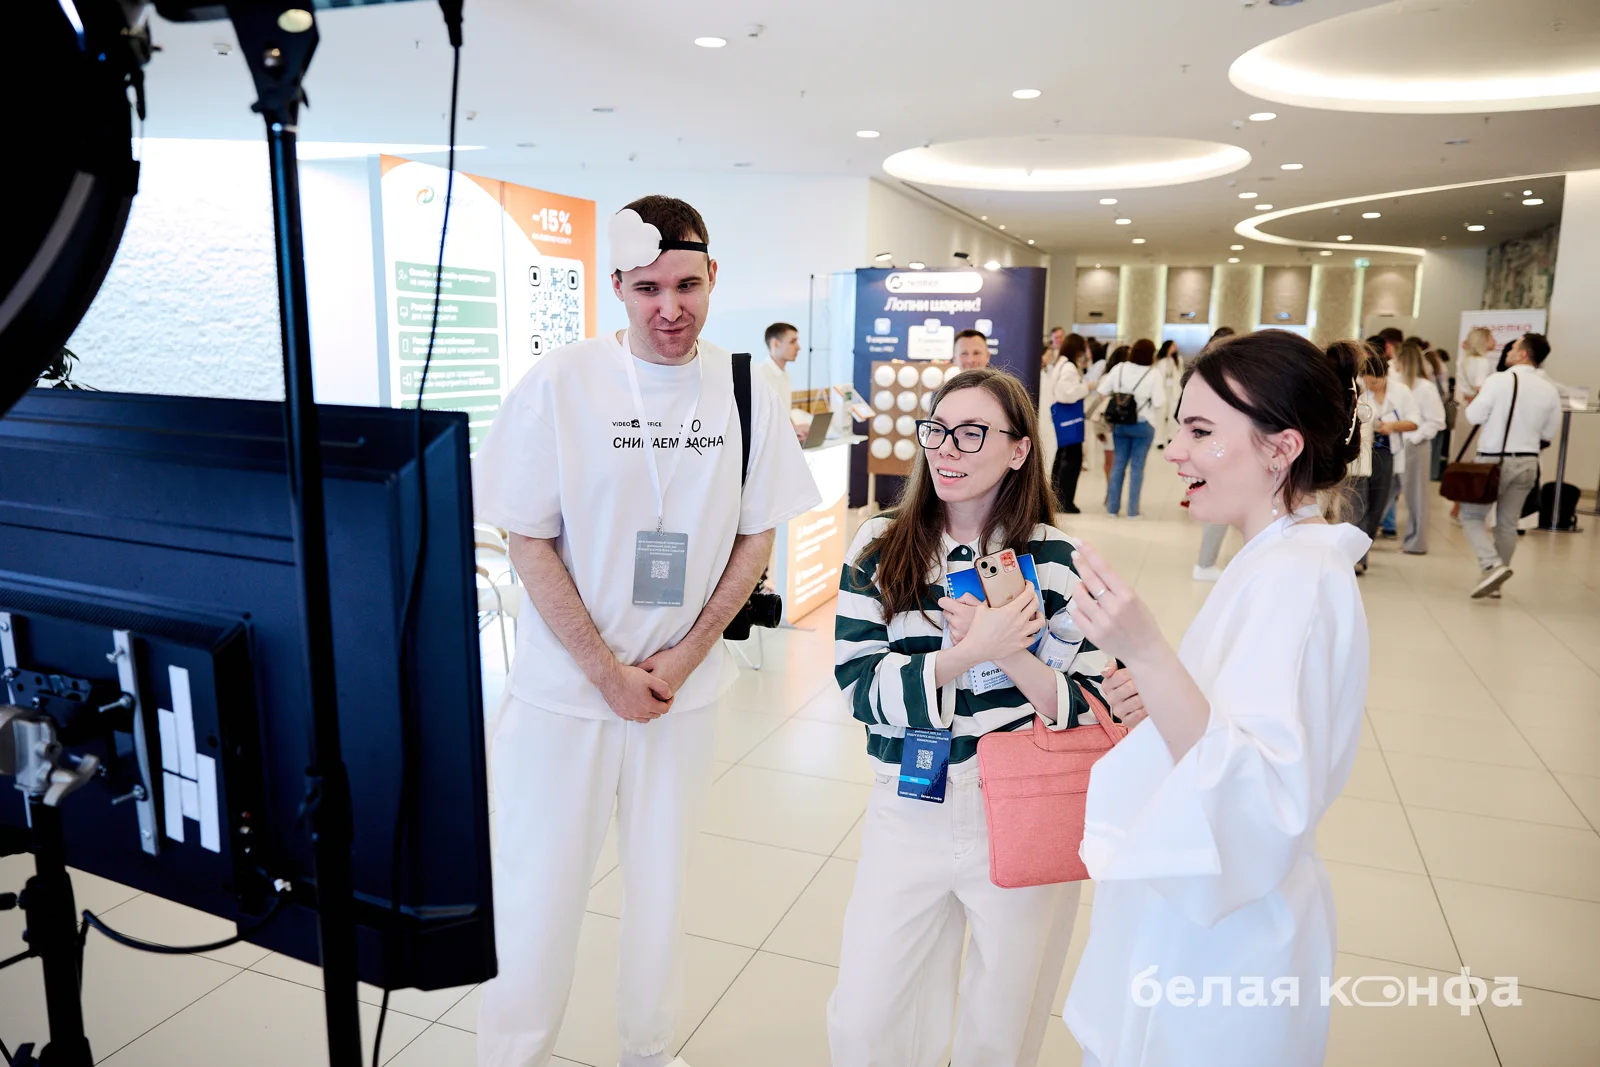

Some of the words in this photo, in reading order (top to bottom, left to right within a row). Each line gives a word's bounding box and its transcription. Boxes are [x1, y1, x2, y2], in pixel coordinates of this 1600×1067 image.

[532, 208, 572, 235] -15%
[884, 297, 929, 312] Лопни
[930, 297, 982, 315] шарик!
[981, 668, 1002, 677] бела
